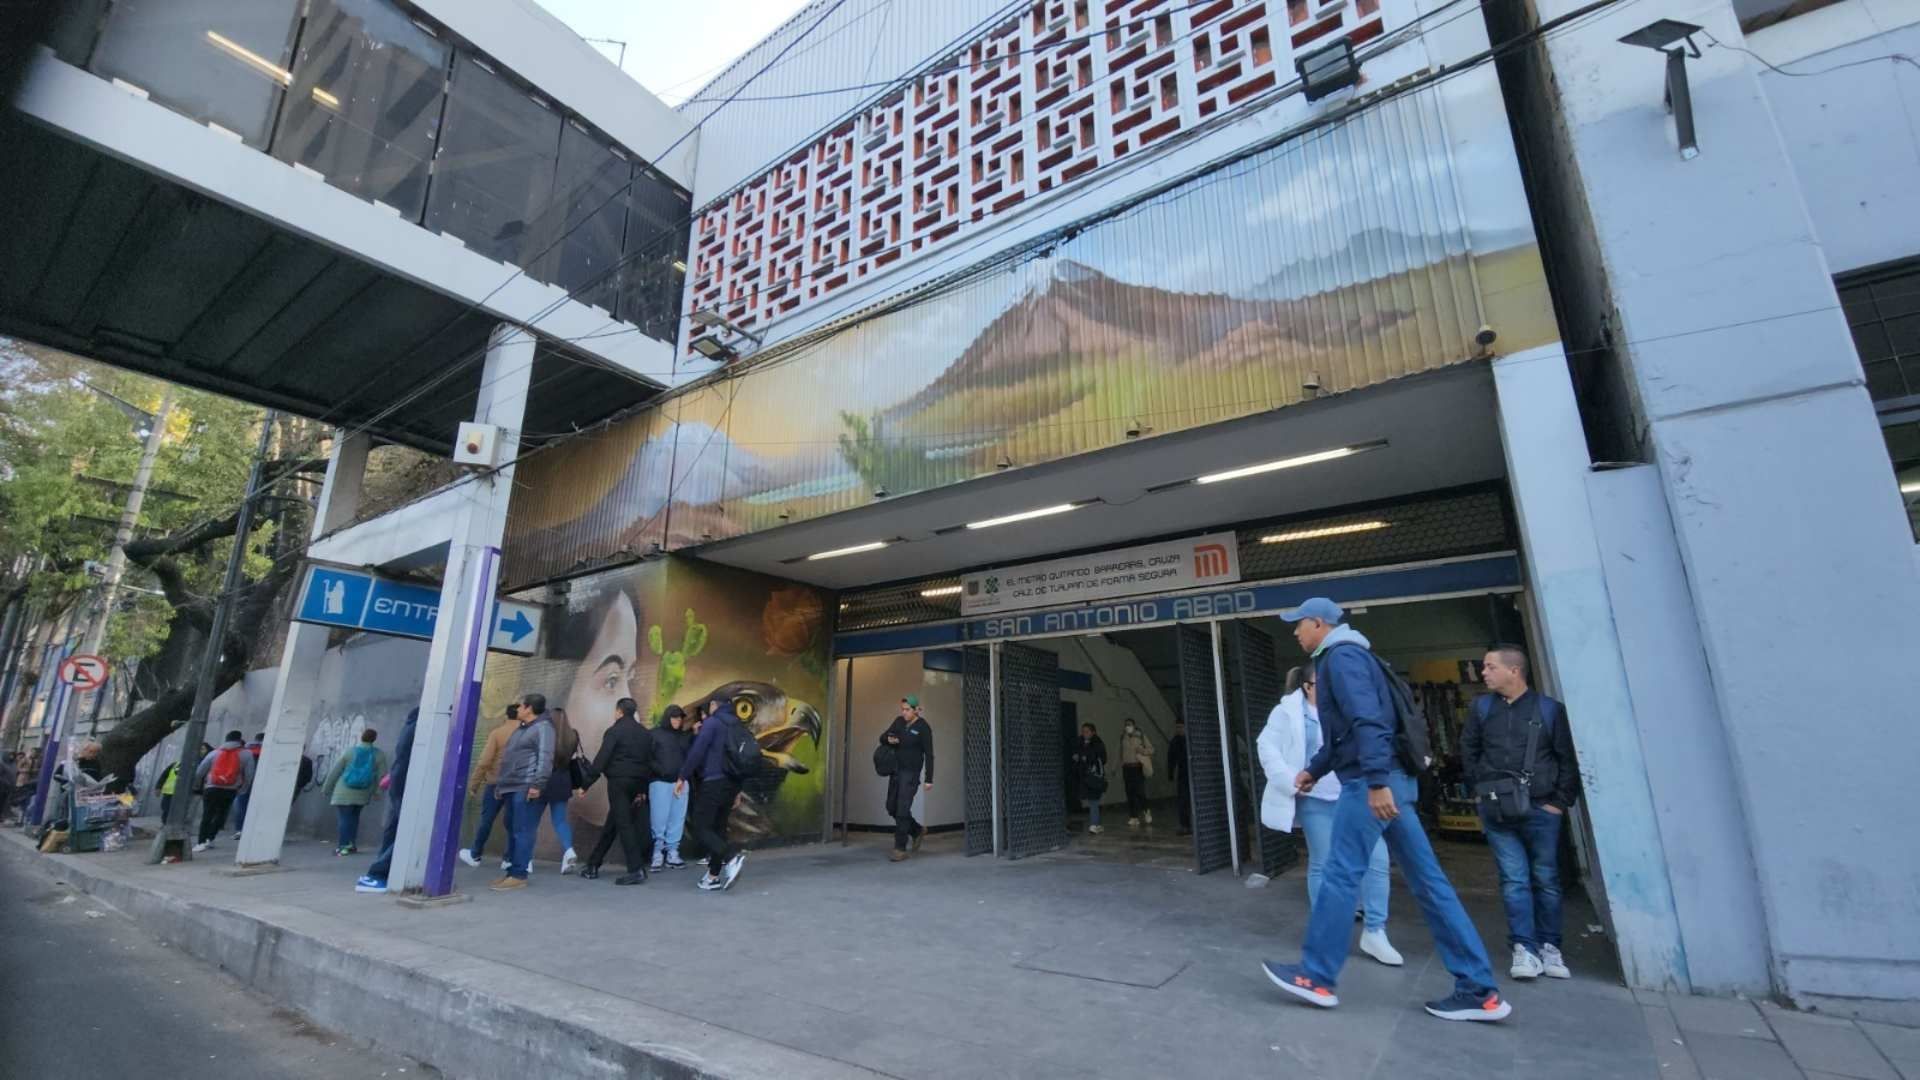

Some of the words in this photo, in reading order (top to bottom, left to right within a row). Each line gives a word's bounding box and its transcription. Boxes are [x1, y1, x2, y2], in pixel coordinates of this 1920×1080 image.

[1006, 577, 1017, 587] EL
[1018, 573, 1047, 585] METRO
[1048, 567, 1090, 581] QUITANDO
[1148, 553, 1181, 567] CRUZA
[1035, 586, 1048, 595] DE
[1086, 579, 1099, 589] DE
[1100, 574, 1136, 586] FORMA
[1138, 568, 1178, 582] SEGURA
[374, 597, 439, 621] ENTR
[984, 616, 1032, 637] SAN
[1044, 602, 1158, 630] ANTONIO
[1173, 591, 1256, 618] ABAD
